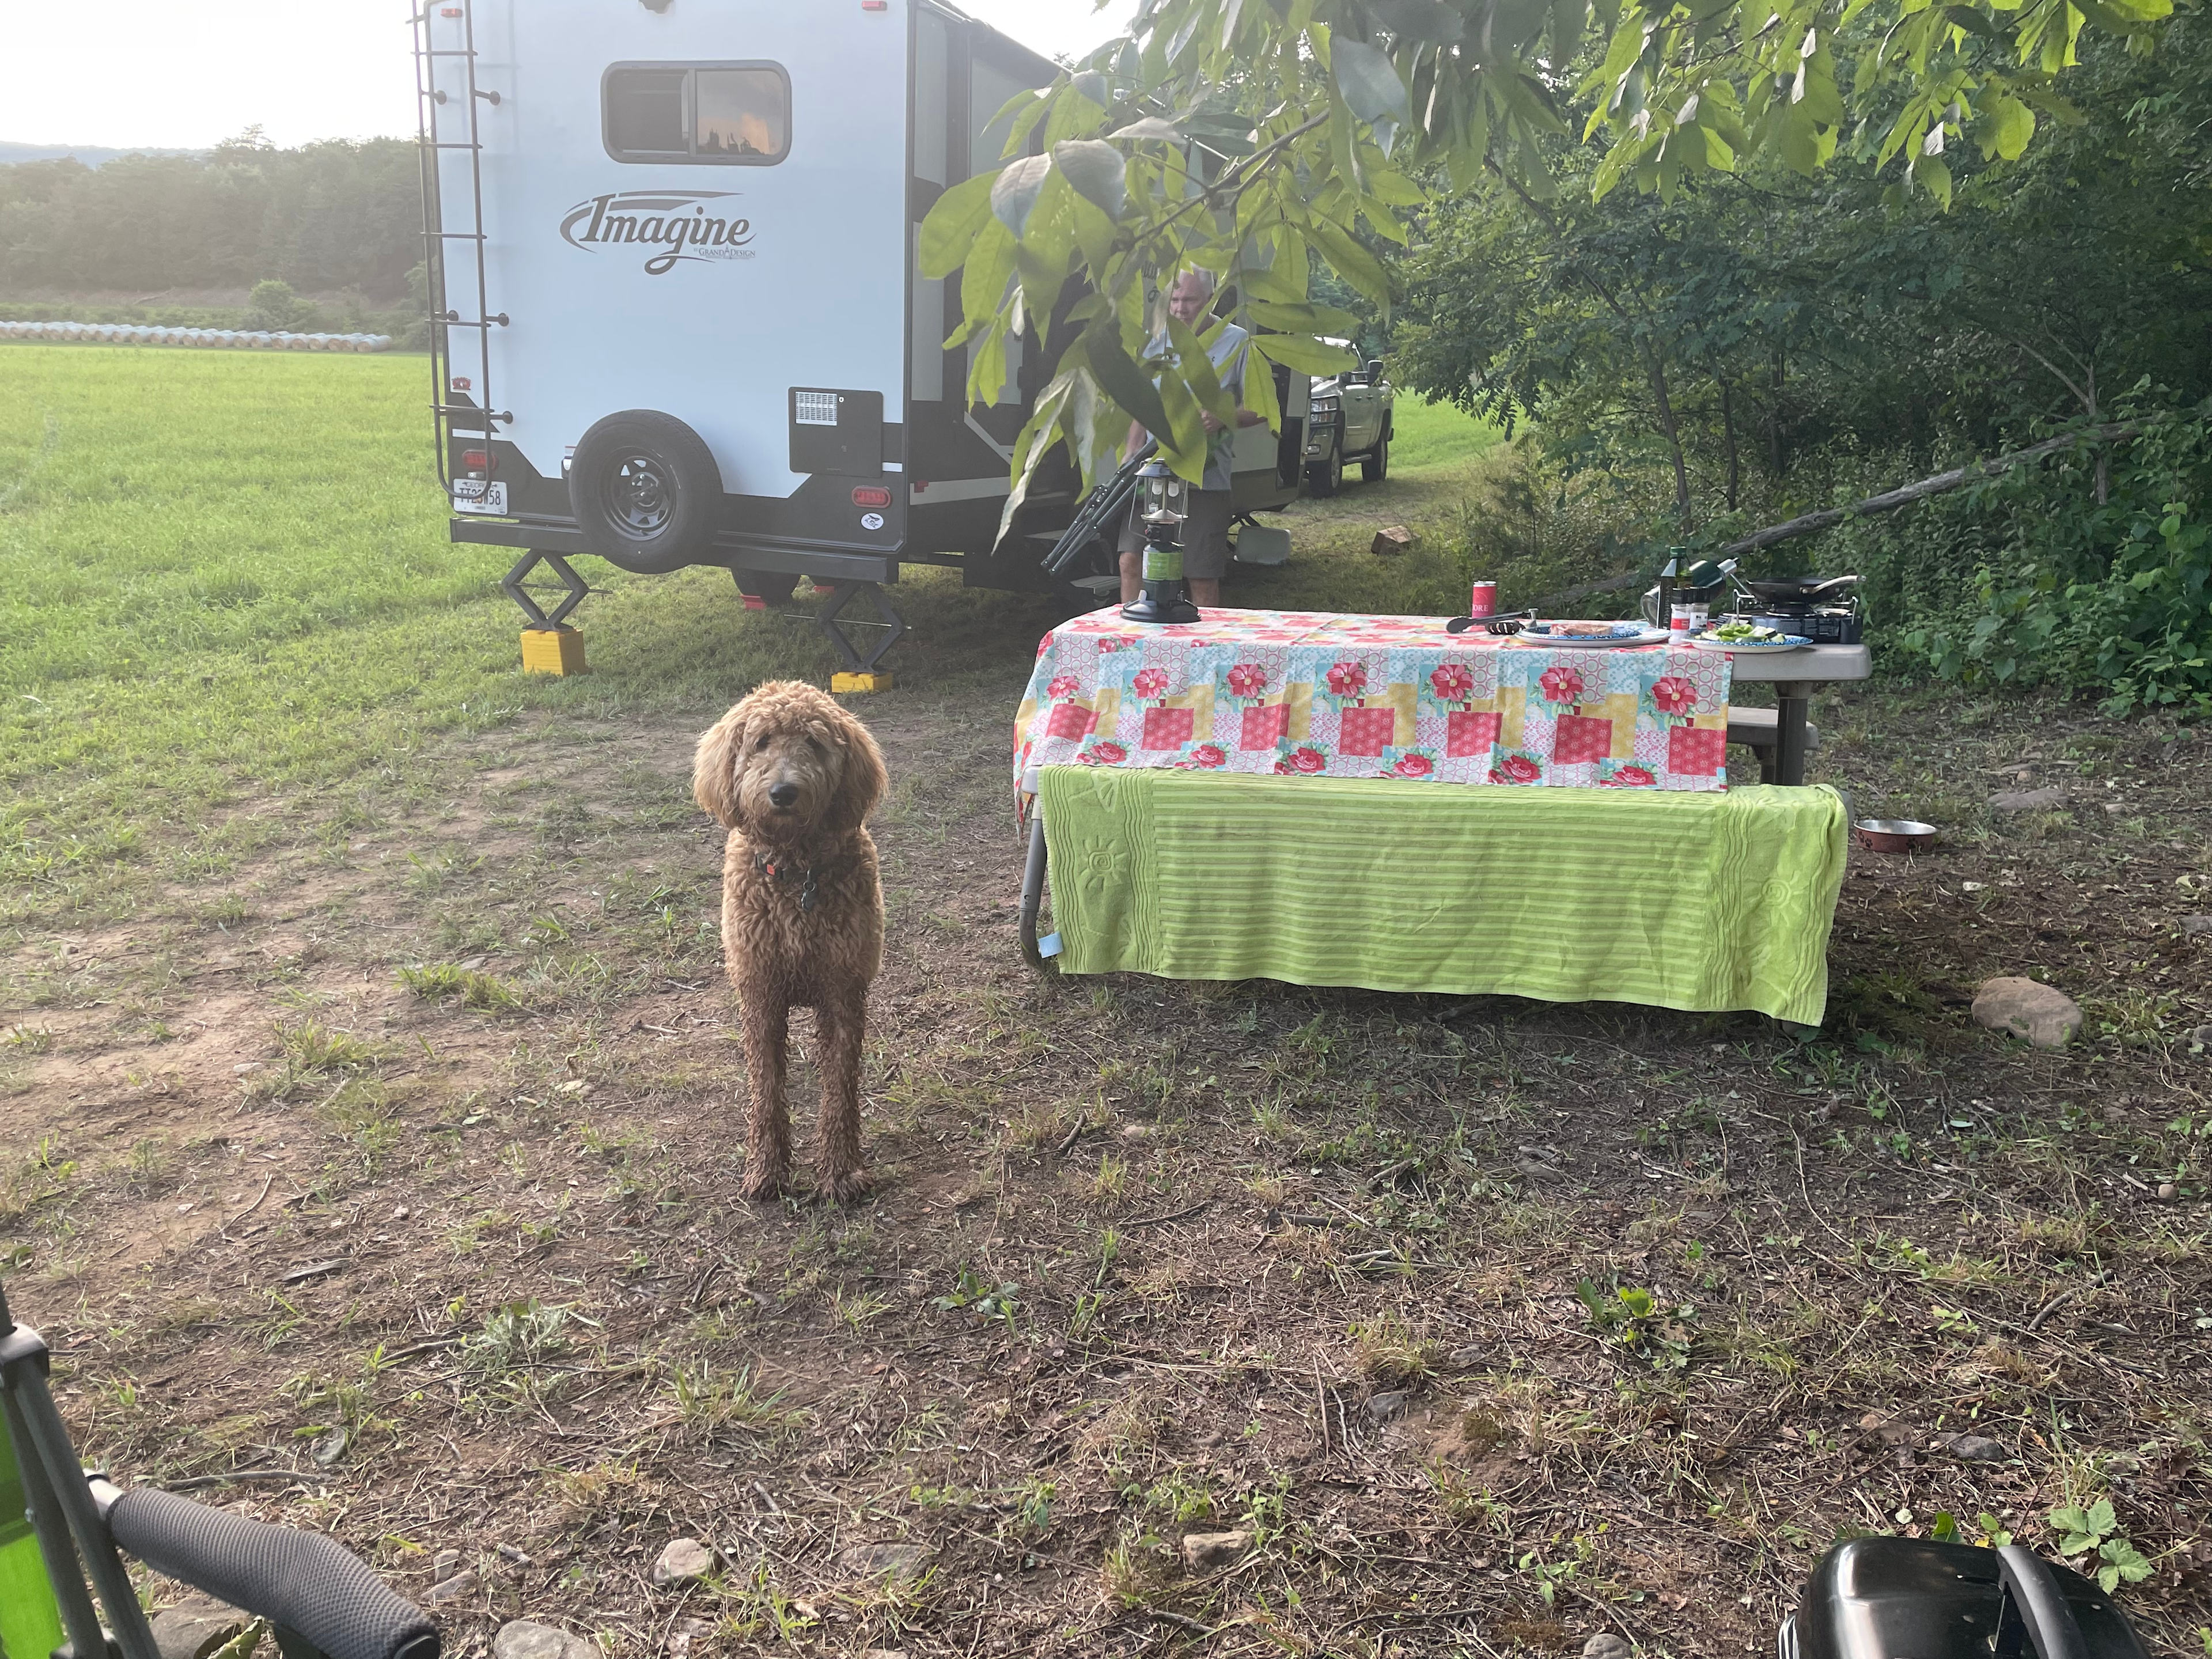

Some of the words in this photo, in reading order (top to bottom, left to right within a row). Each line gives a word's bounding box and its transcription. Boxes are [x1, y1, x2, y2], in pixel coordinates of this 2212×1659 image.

[578, 194, 756, 274] Imagine
[699, 248, 724, 256] GRAND
[730, 248, 756, 257] DESIGN
[1472, 604, 1488, 612] ORE
